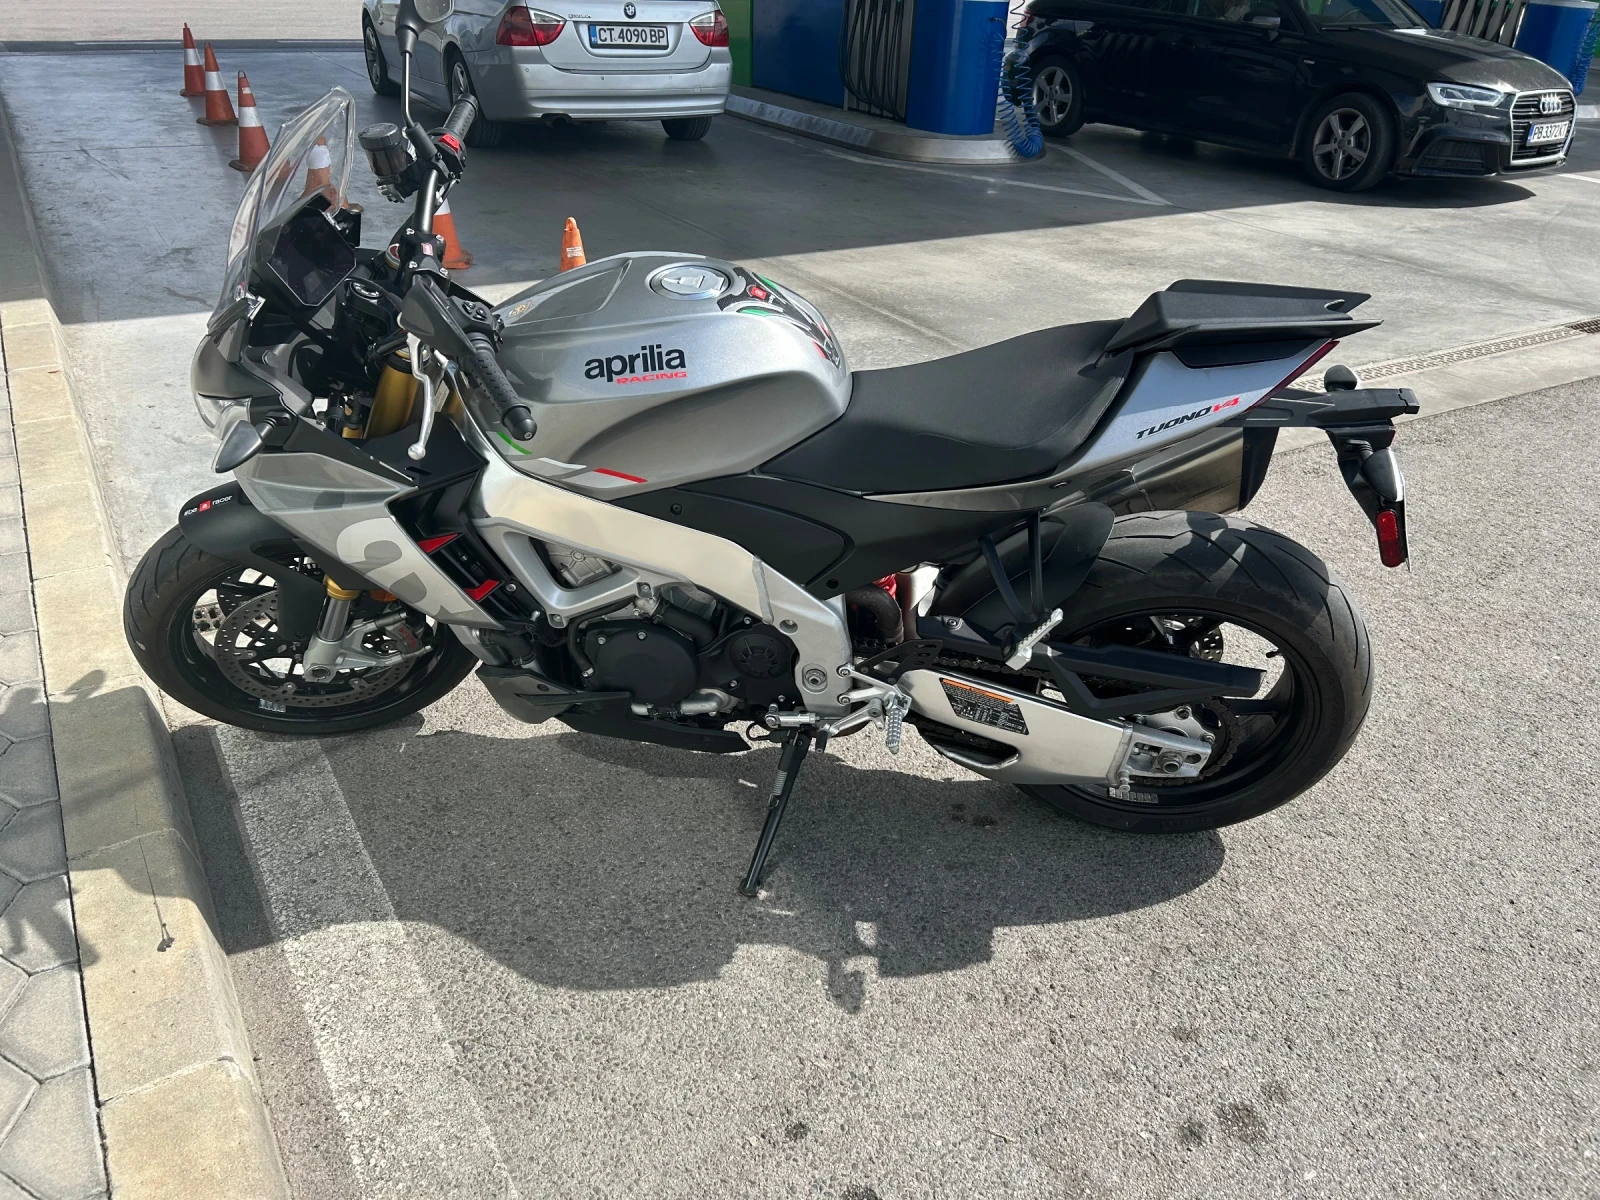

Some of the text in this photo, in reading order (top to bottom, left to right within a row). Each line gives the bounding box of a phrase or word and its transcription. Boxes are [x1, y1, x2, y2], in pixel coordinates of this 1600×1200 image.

[598, 27, 665, 43] CT 4090 BP
[584, 343, 687, 383] aprilia
[615, 371, 688, 385] RACING
[1135, 405, 1213, 440] TUONO
